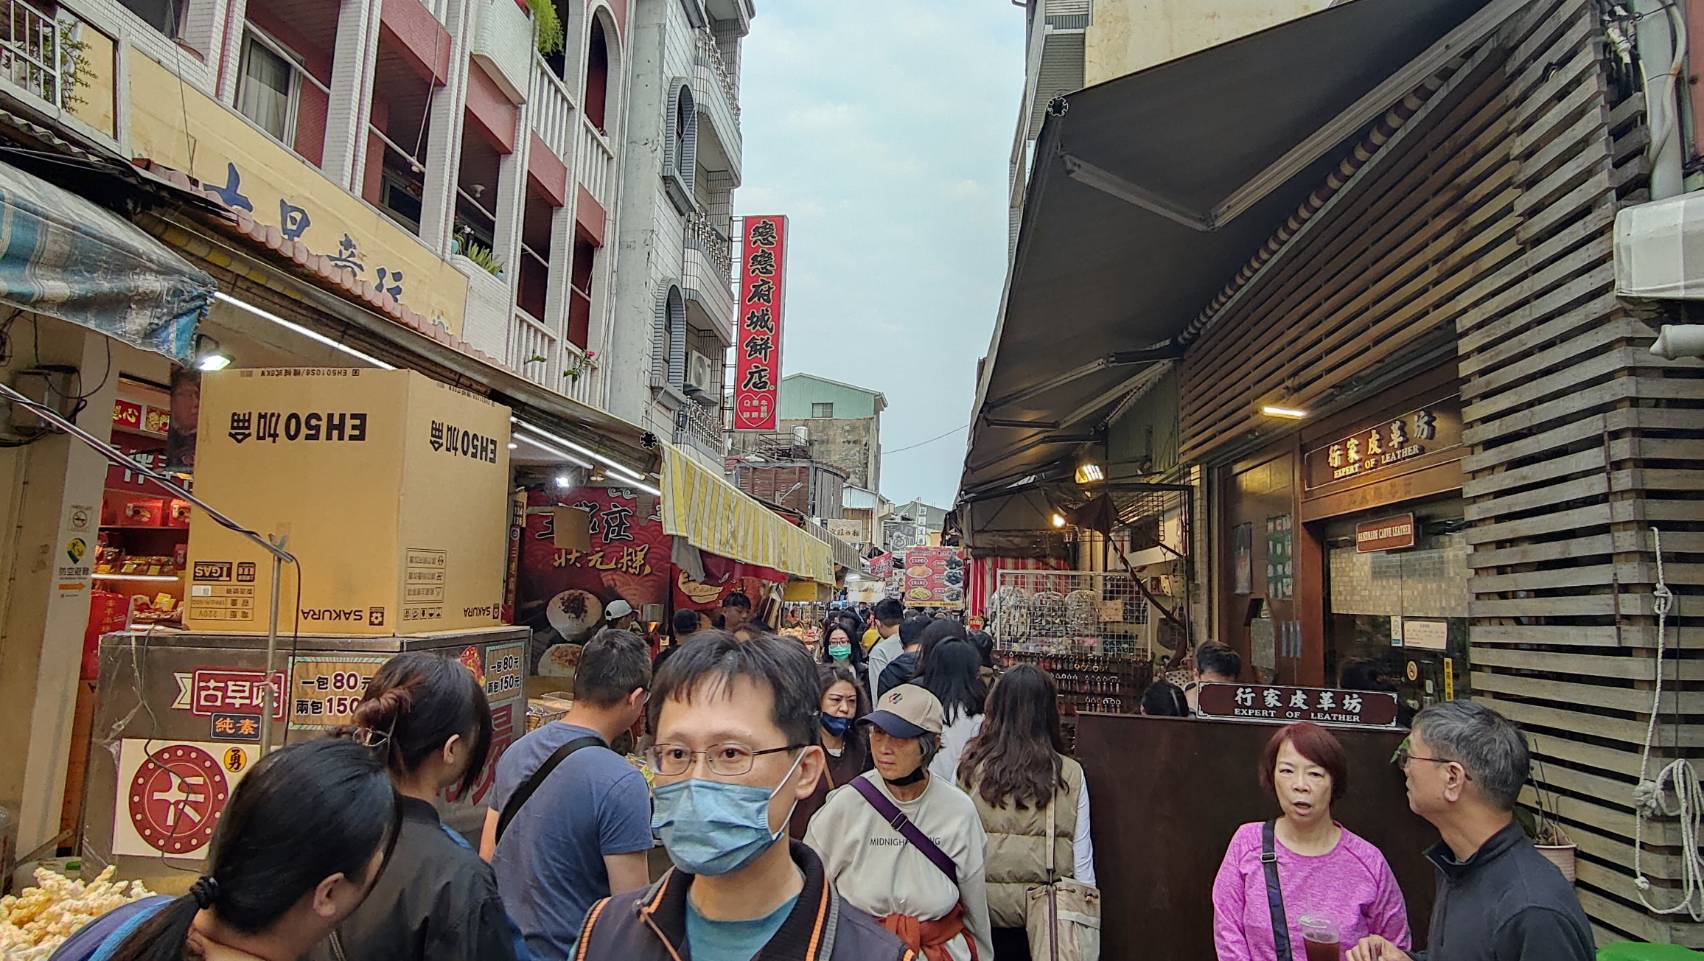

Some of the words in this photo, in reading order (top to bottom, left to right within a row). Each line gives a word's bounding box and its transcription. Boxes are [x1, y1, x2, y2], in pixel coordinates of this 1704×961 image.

[228, 411, 367, 443] EH50加侖
[1328, 410, 1431, 467] 行家皮革坊
[429, 420, 497, 464] EH50加侖
[1334, 465, 1360, 479] EXPERT
[1365, 458, 1376, 469] OF
[1381, 444, 1419, 463] LEATHER
[301, 609, 363, 621] SAKURA
[463, 607, 490, 617] SAKURA
[199, 679, 279, 708] 古早味
[1235, 687, 1362, 713] 行家皮革坊
[215, 717, 258, 735] 純素
[1234, 708, 1277, 717] EXPERT
[1285, 711, 1300, 719] OF
[1311, 712, 1360, 722] LEATHER
[230, 749, 241, 770] 勇
[870, 837, 909, 846] MIDNIGH
